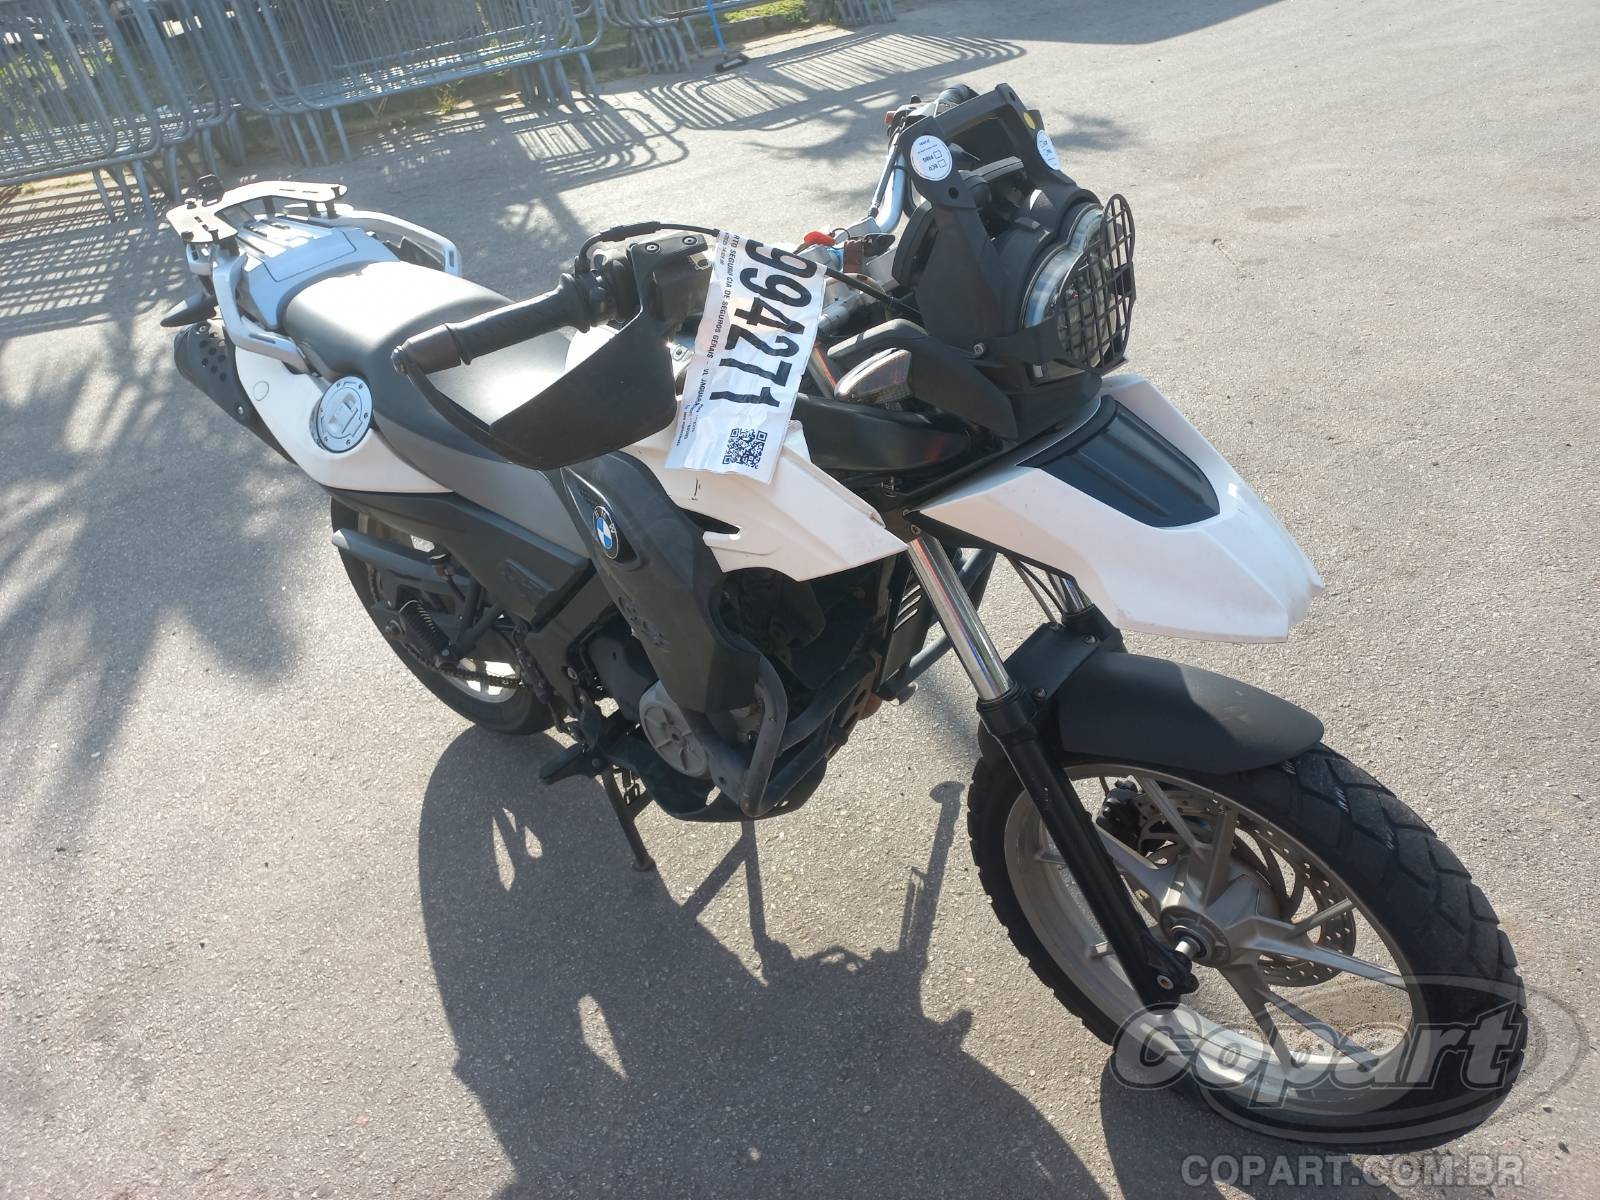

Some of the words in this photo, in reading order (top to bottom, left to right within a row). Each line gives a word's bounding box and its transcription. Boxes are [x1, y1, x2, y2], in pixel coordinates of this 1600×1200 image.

[726, 276, 734, 288] CIA
[724, 290, 731, 299] DE
[709, 239, 817, 408] 994271
[714, 301, 729, 333] SEGUROS
[707, 335, 719, 359] GERAIS
